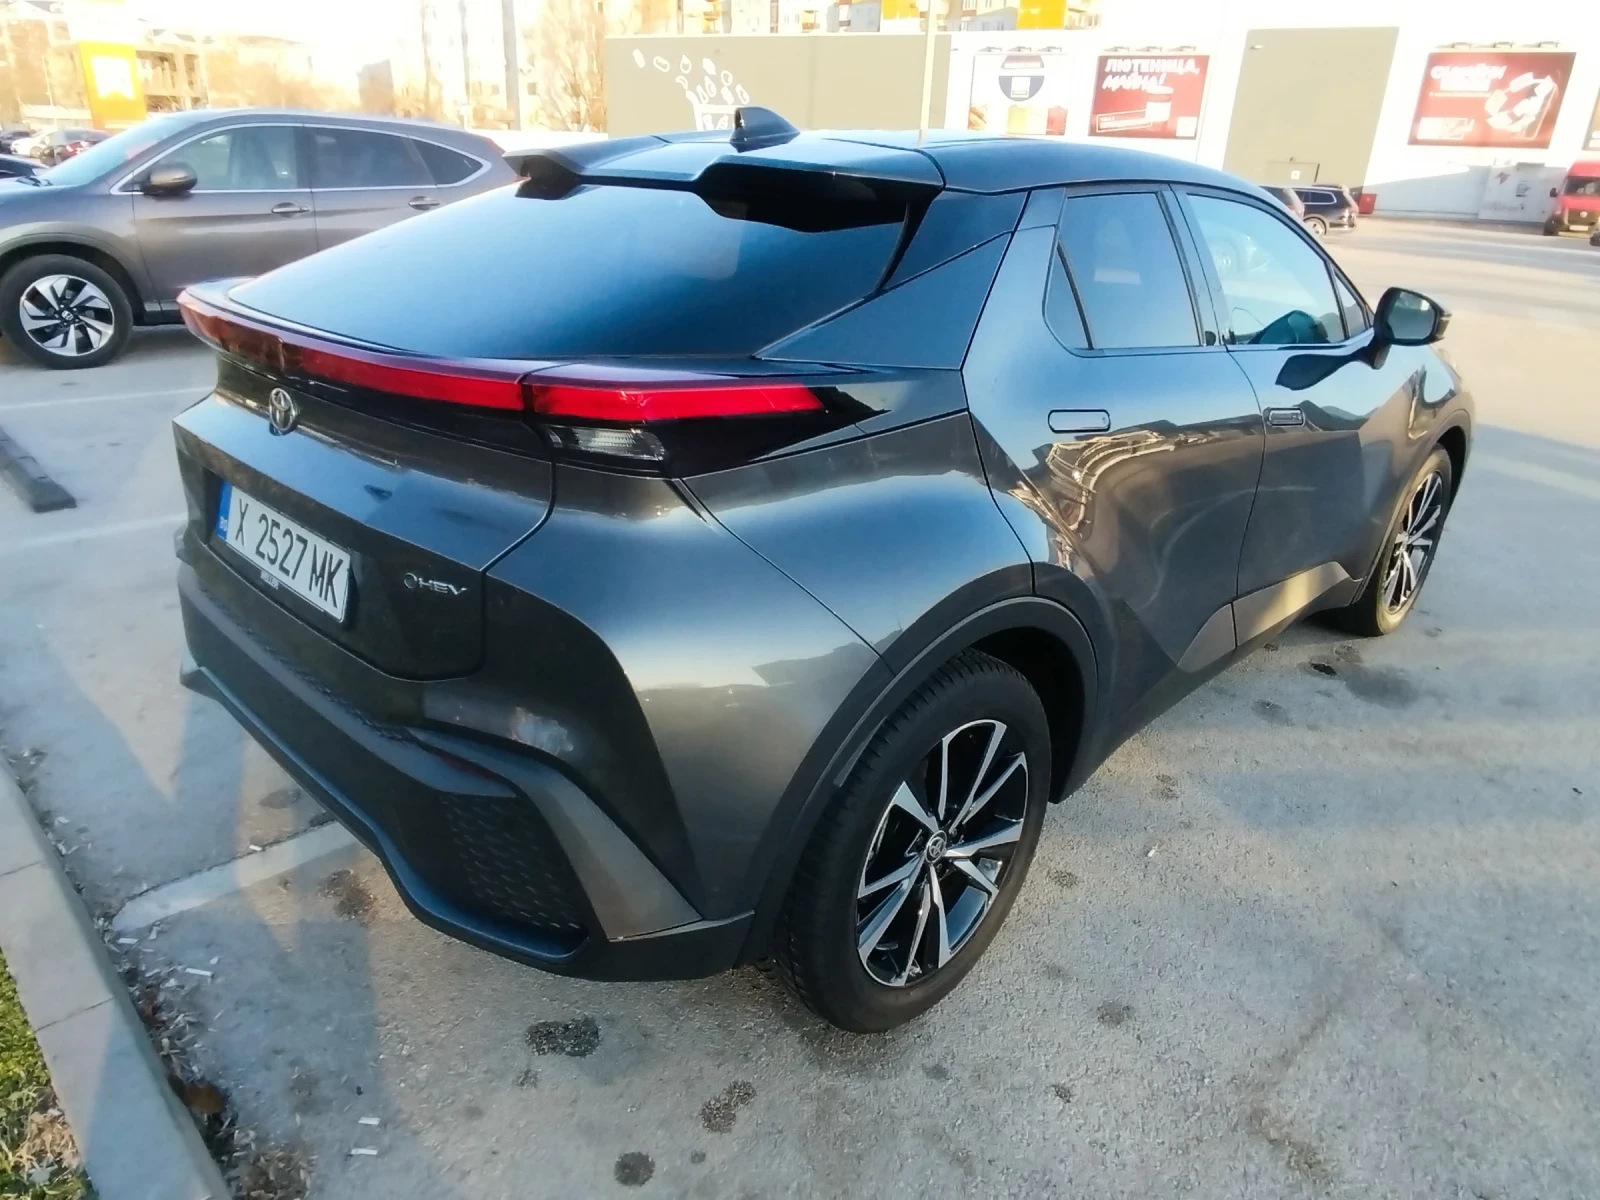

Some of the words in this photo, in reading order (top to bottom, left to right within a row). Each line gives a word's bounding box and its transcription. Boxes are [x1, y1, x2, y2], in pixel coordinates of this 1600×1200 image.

[1105, 58, 1200, 75] ЛЮТЕНИЦА,
[235, 499, 249, 546] X
[255, 513, 308, 580] 2527
[308, 544, 344, 608] MK
[418, 577, 467, 595] HEV
